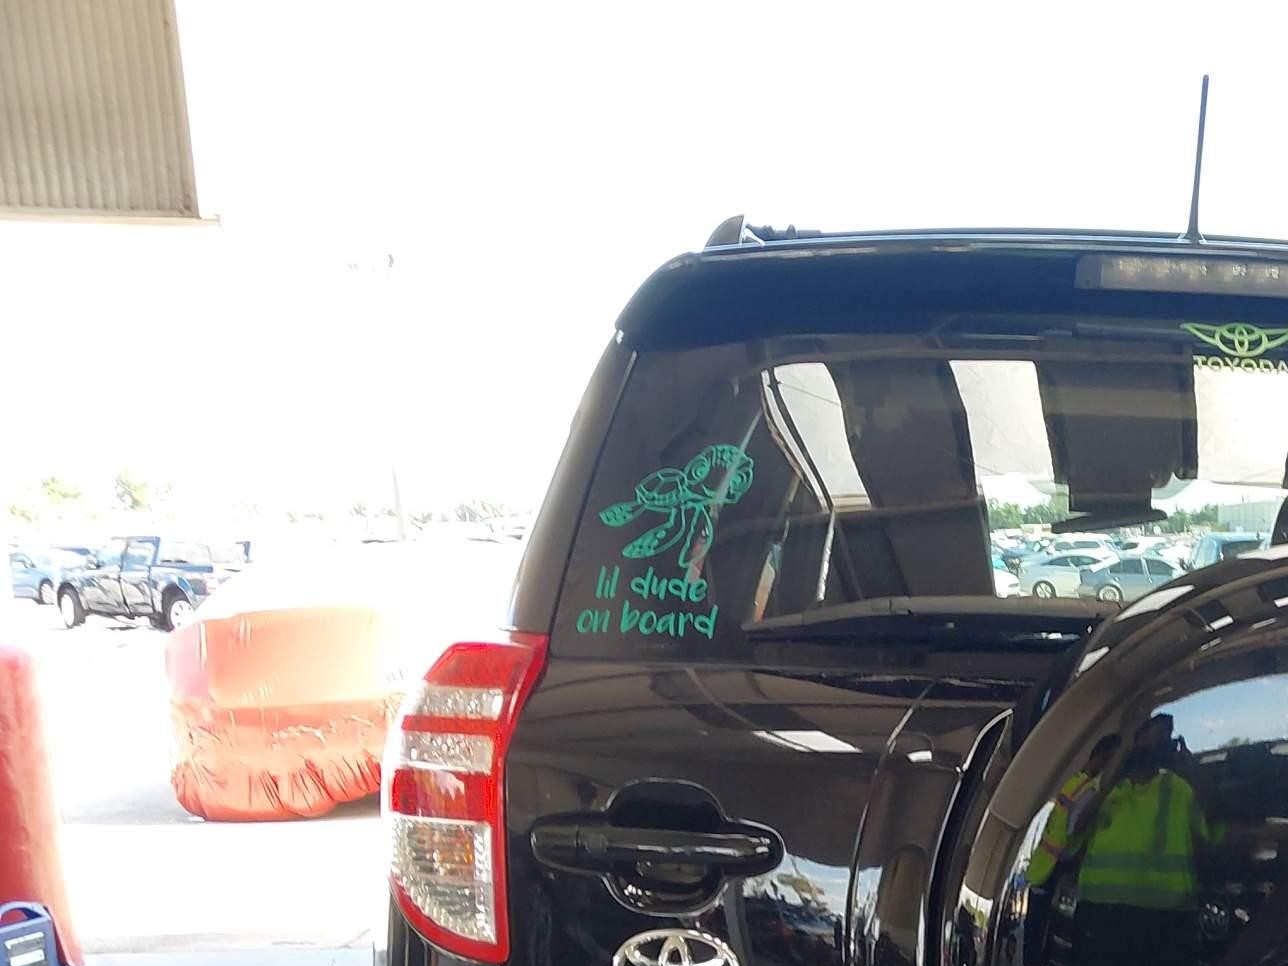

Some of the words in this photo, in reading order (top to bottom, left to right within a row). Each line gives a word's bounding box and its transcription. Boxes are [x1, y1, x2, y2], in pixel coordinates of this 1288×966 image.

[630, 565, 708, 602] dude
[576, 608, 611, 634] on
[620, 600, 719, 640] board
